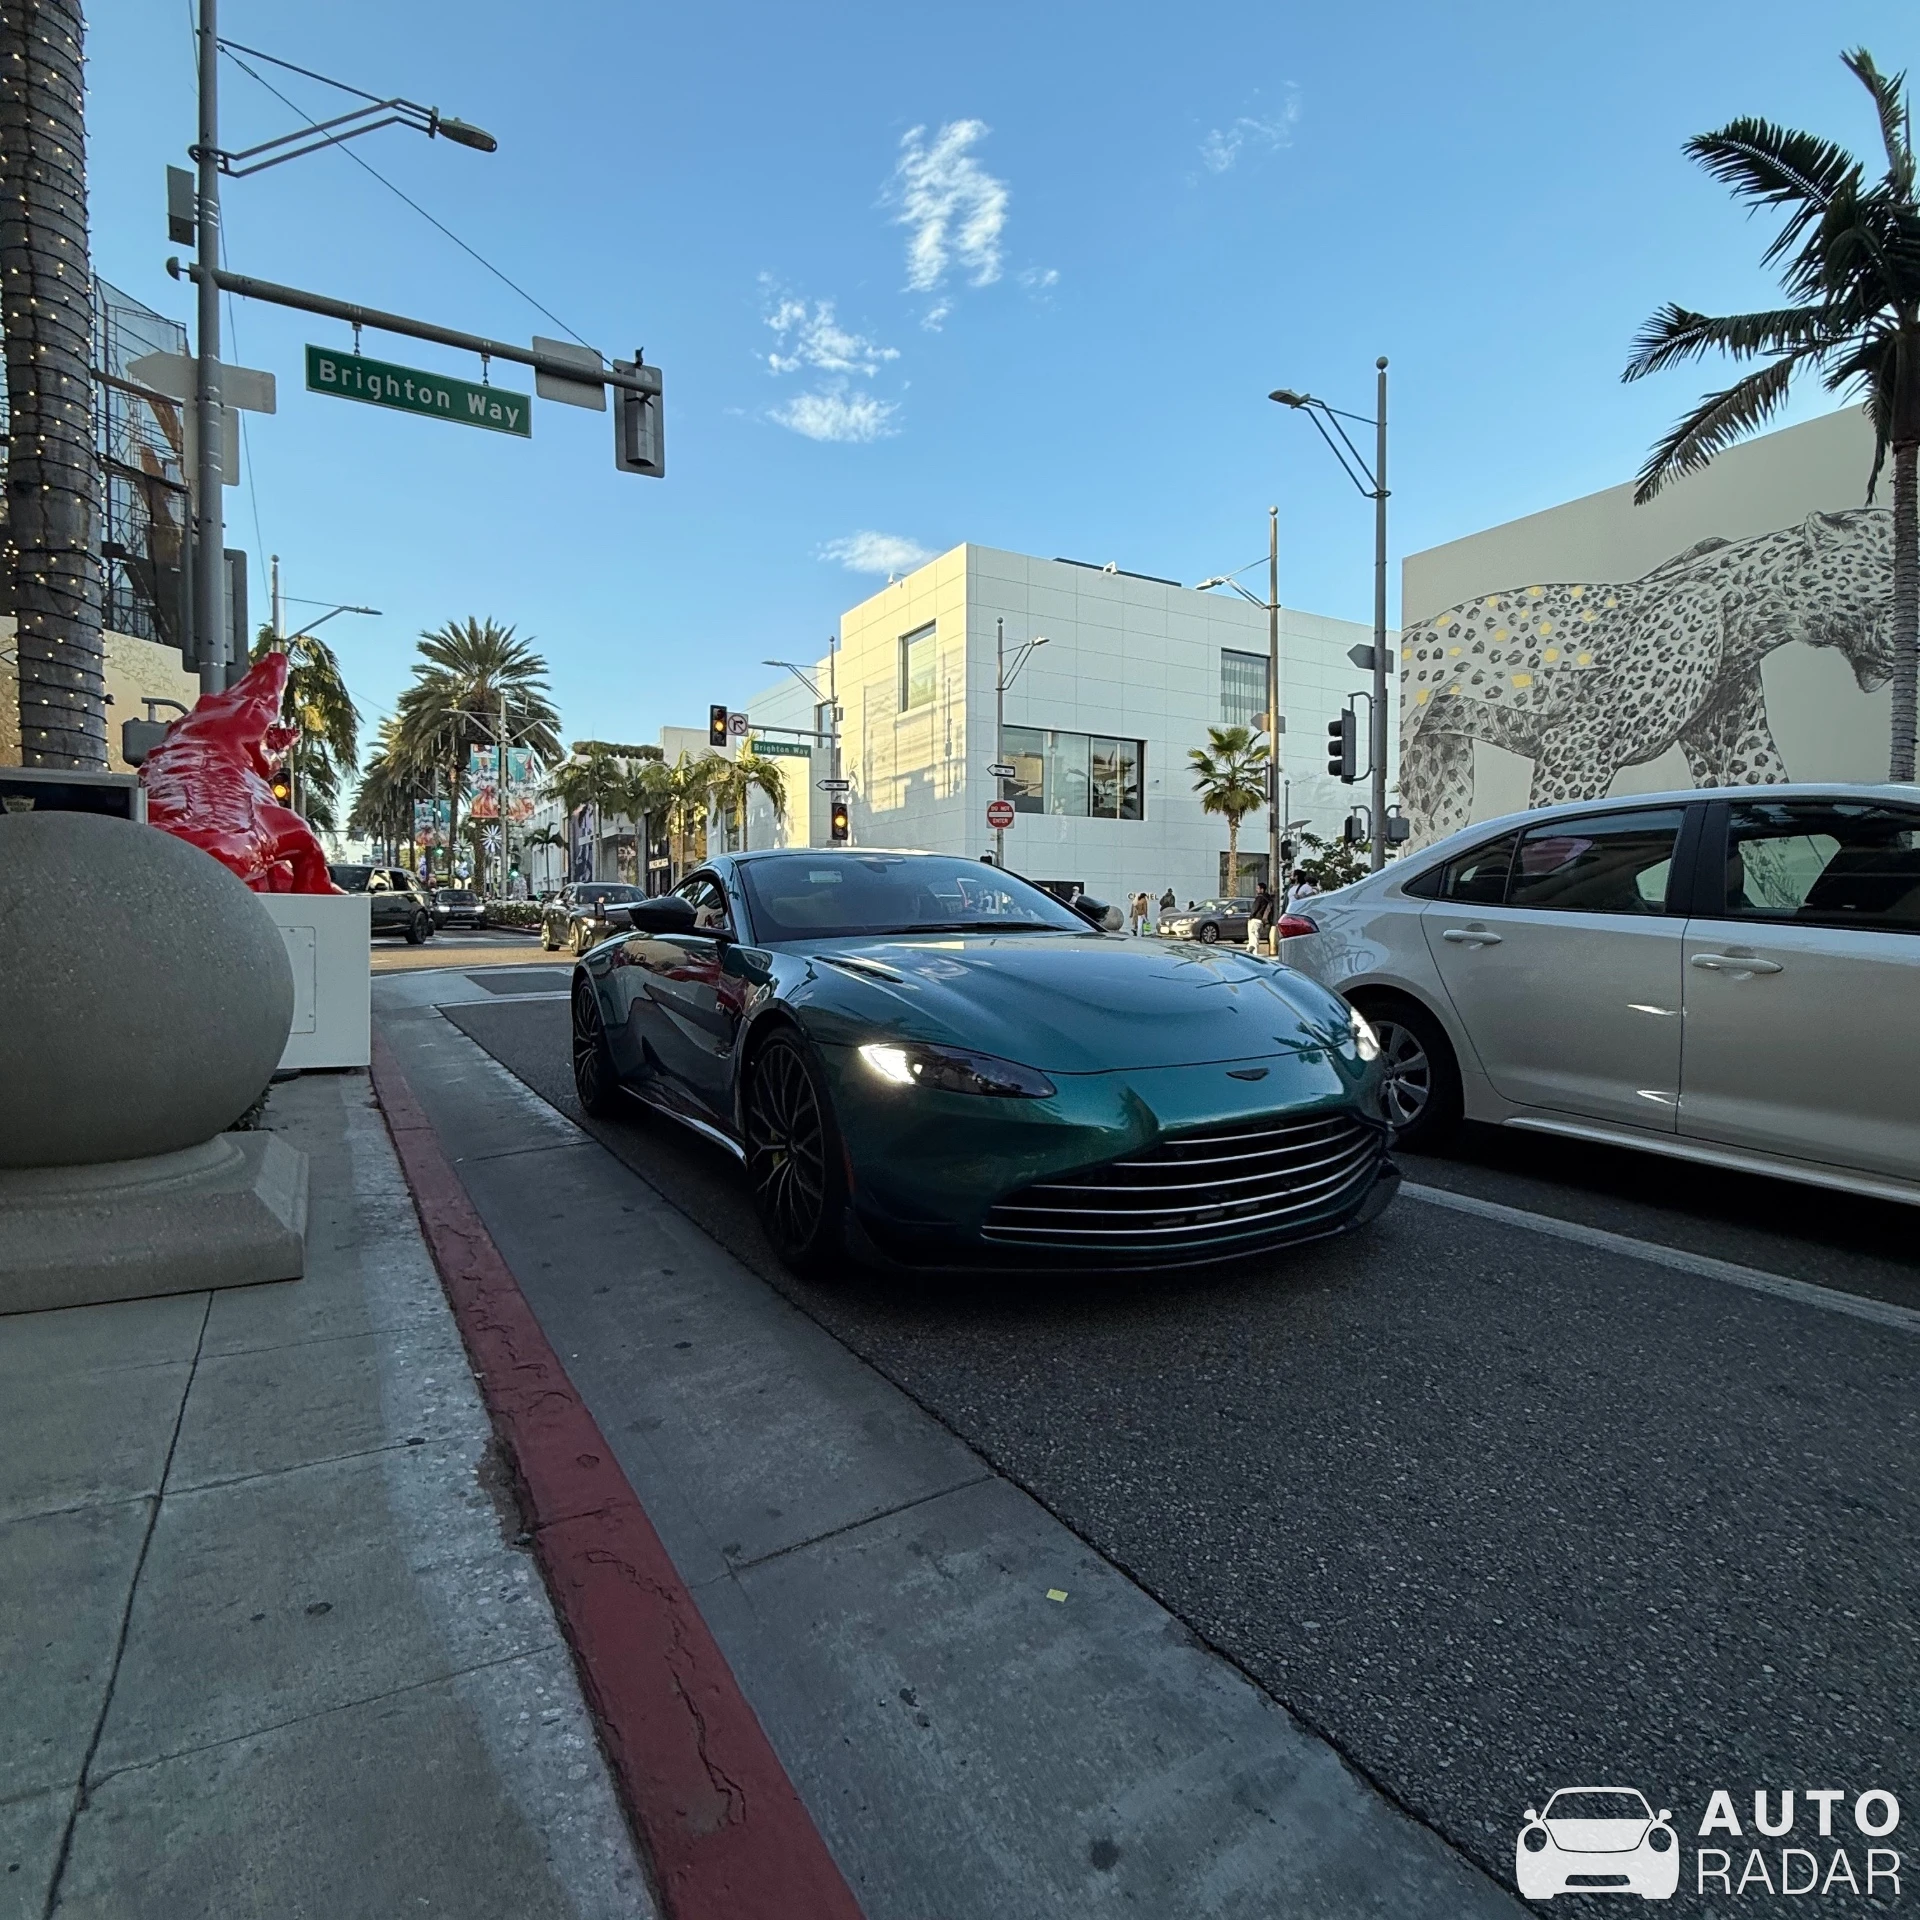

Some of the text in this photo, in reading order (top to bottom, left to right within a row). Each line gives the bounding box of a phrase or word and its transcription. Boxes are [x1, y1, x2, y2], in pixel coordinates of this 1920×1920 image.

[319, 358, 520, 428] Brighton Way
[753, 743, 809, 756] Brighton Way
